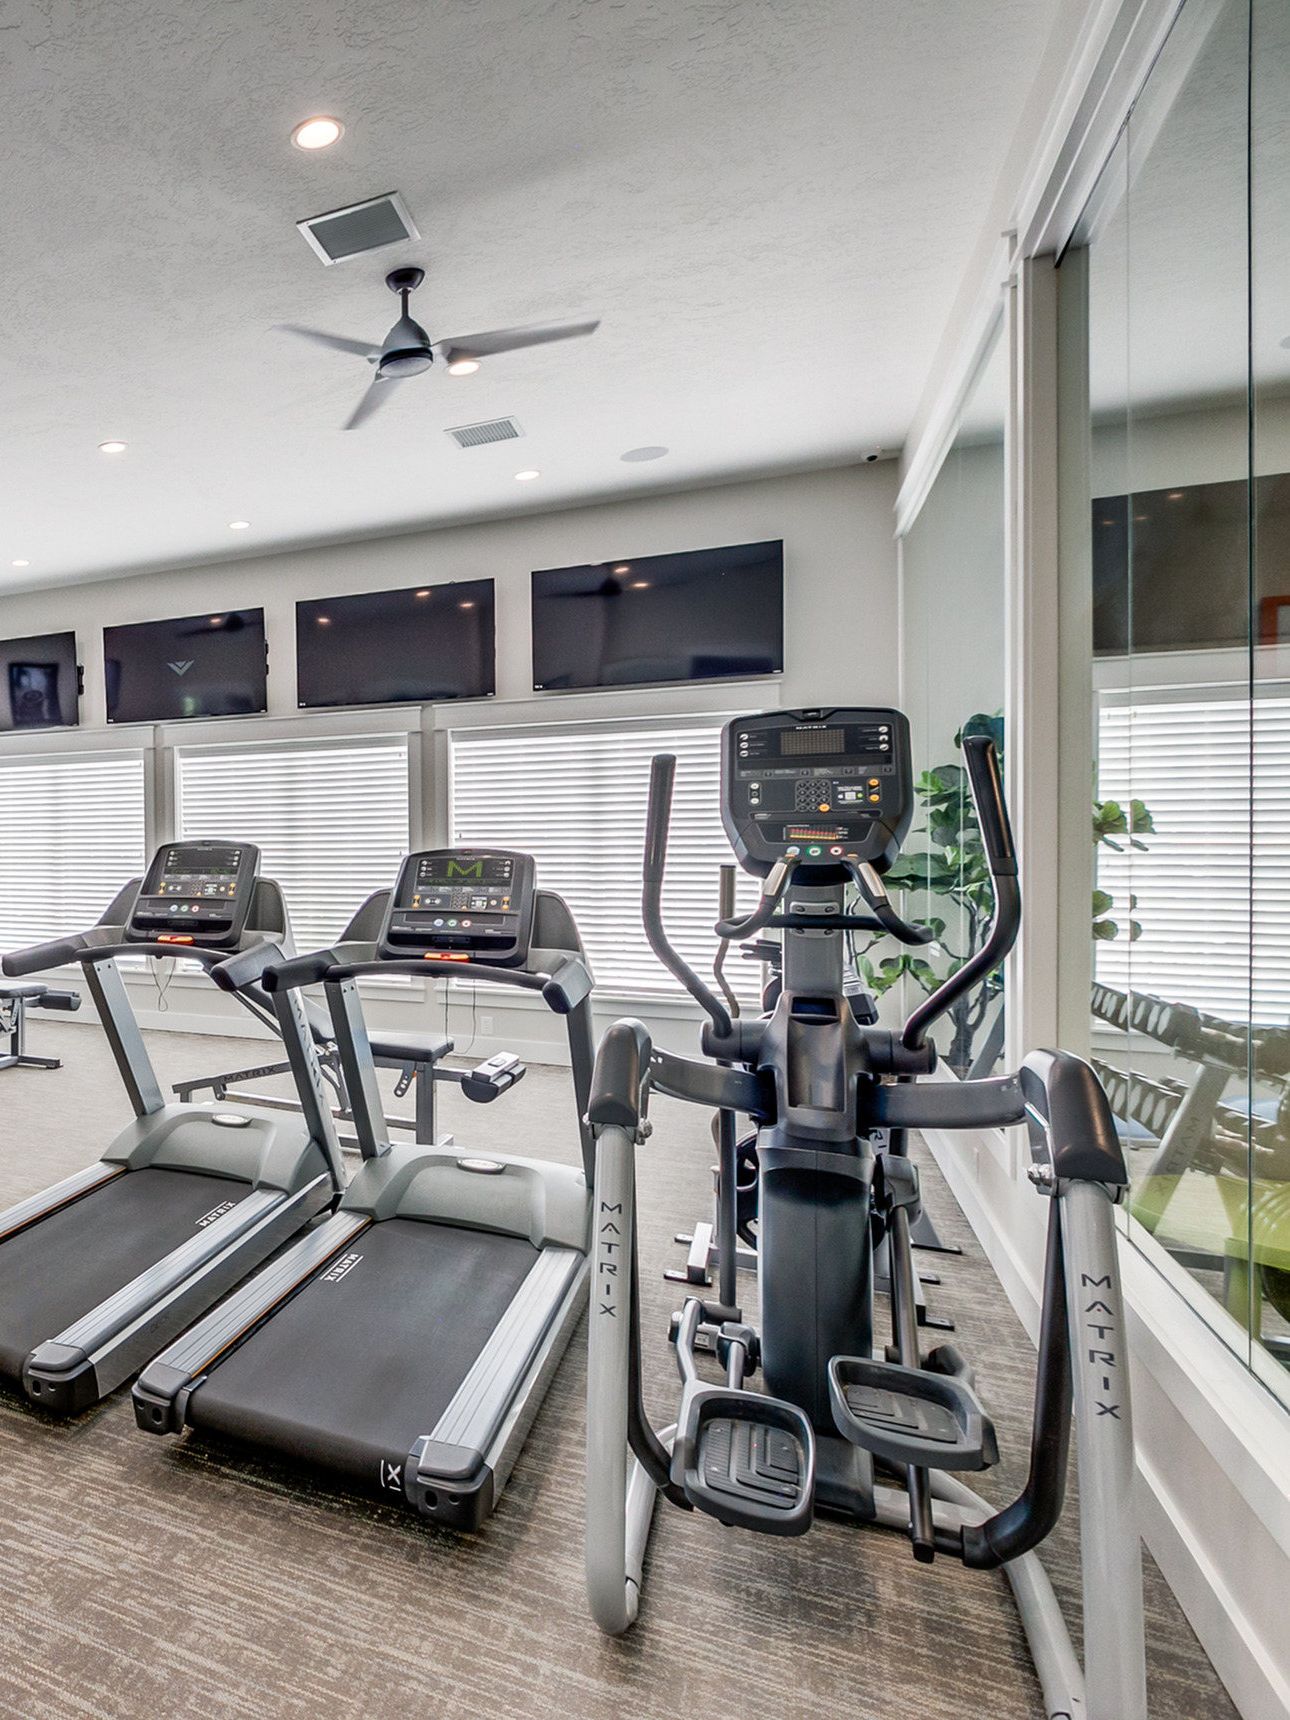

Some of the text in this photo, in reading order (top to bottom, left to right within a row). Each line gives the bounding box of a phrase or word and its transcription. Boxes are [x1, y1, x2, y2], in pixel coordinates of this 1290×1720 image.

[447, 861, 483, 877] M
[224, 1066, 276, 1082] MATRIX
[199, 1201, 236, 1227] MATRIX
[324, 1253, 359, 1281] MATRIX
[599, 1201, 622, 1317] MATRIX
[1081, 1273, 1121, 1420] MATRIX
